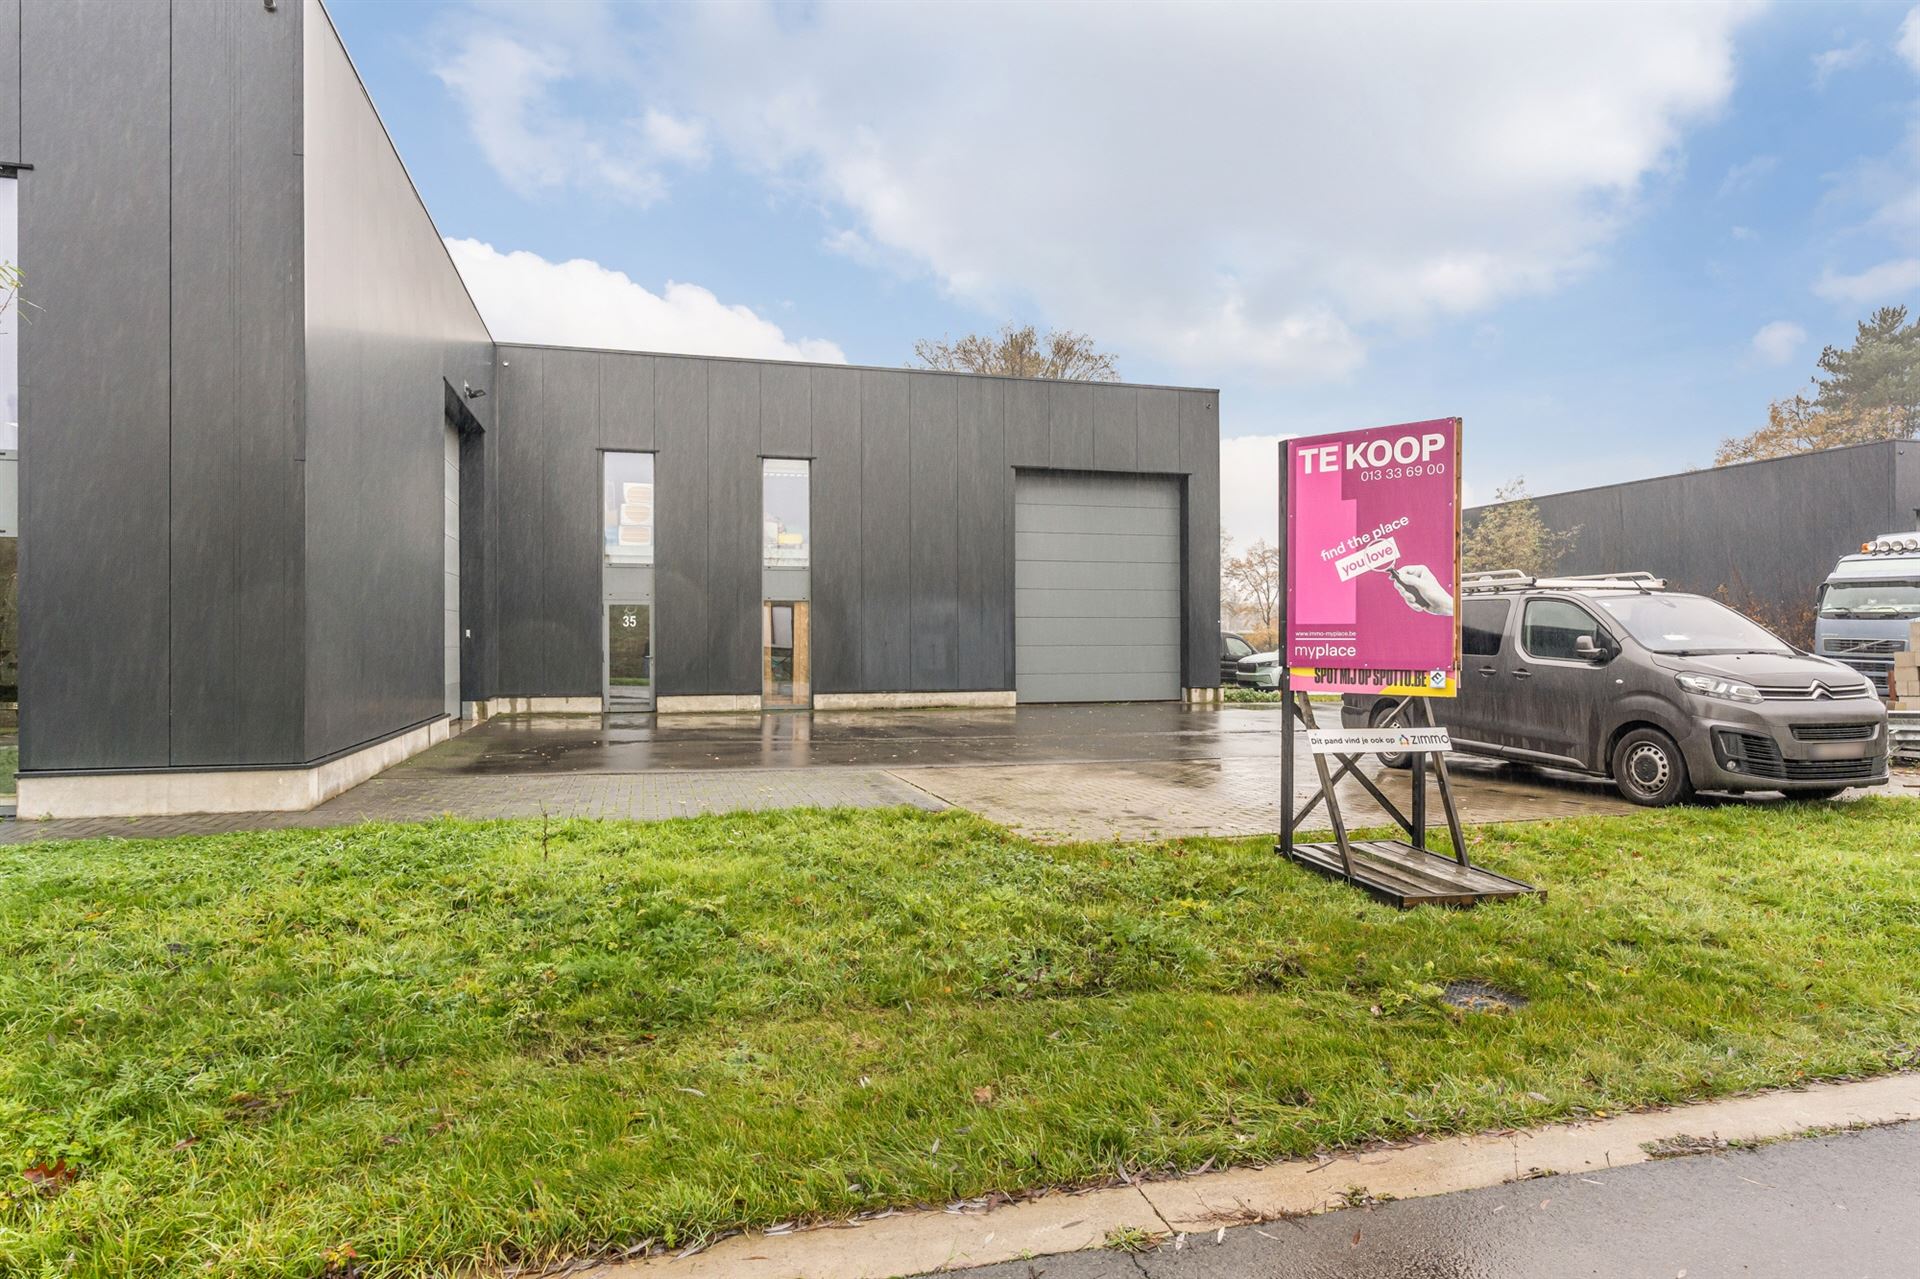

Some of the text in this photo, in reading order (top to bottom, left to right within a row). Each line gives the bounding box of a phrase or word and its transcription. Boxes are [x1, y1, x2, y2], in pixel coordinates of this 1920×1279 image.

[1298, 433, 1445, 474] TE KOOP
[1361, 463, 1445, 481] 013 33 69 00
[1320, 516, 1409, 561] find the place
[1342, 546, 1393, 576] you love
[622, 615, 637, 627] 35
[1295, 643, 1356, 659] myplace
[1314, 667, 1427, 687] SPOT MIJ OP SPOTTO.BE
[1325, 737, 1343, 745] pand
[1362, 737, 1369, 745] je
[1386, 737, 1395, 745] op
